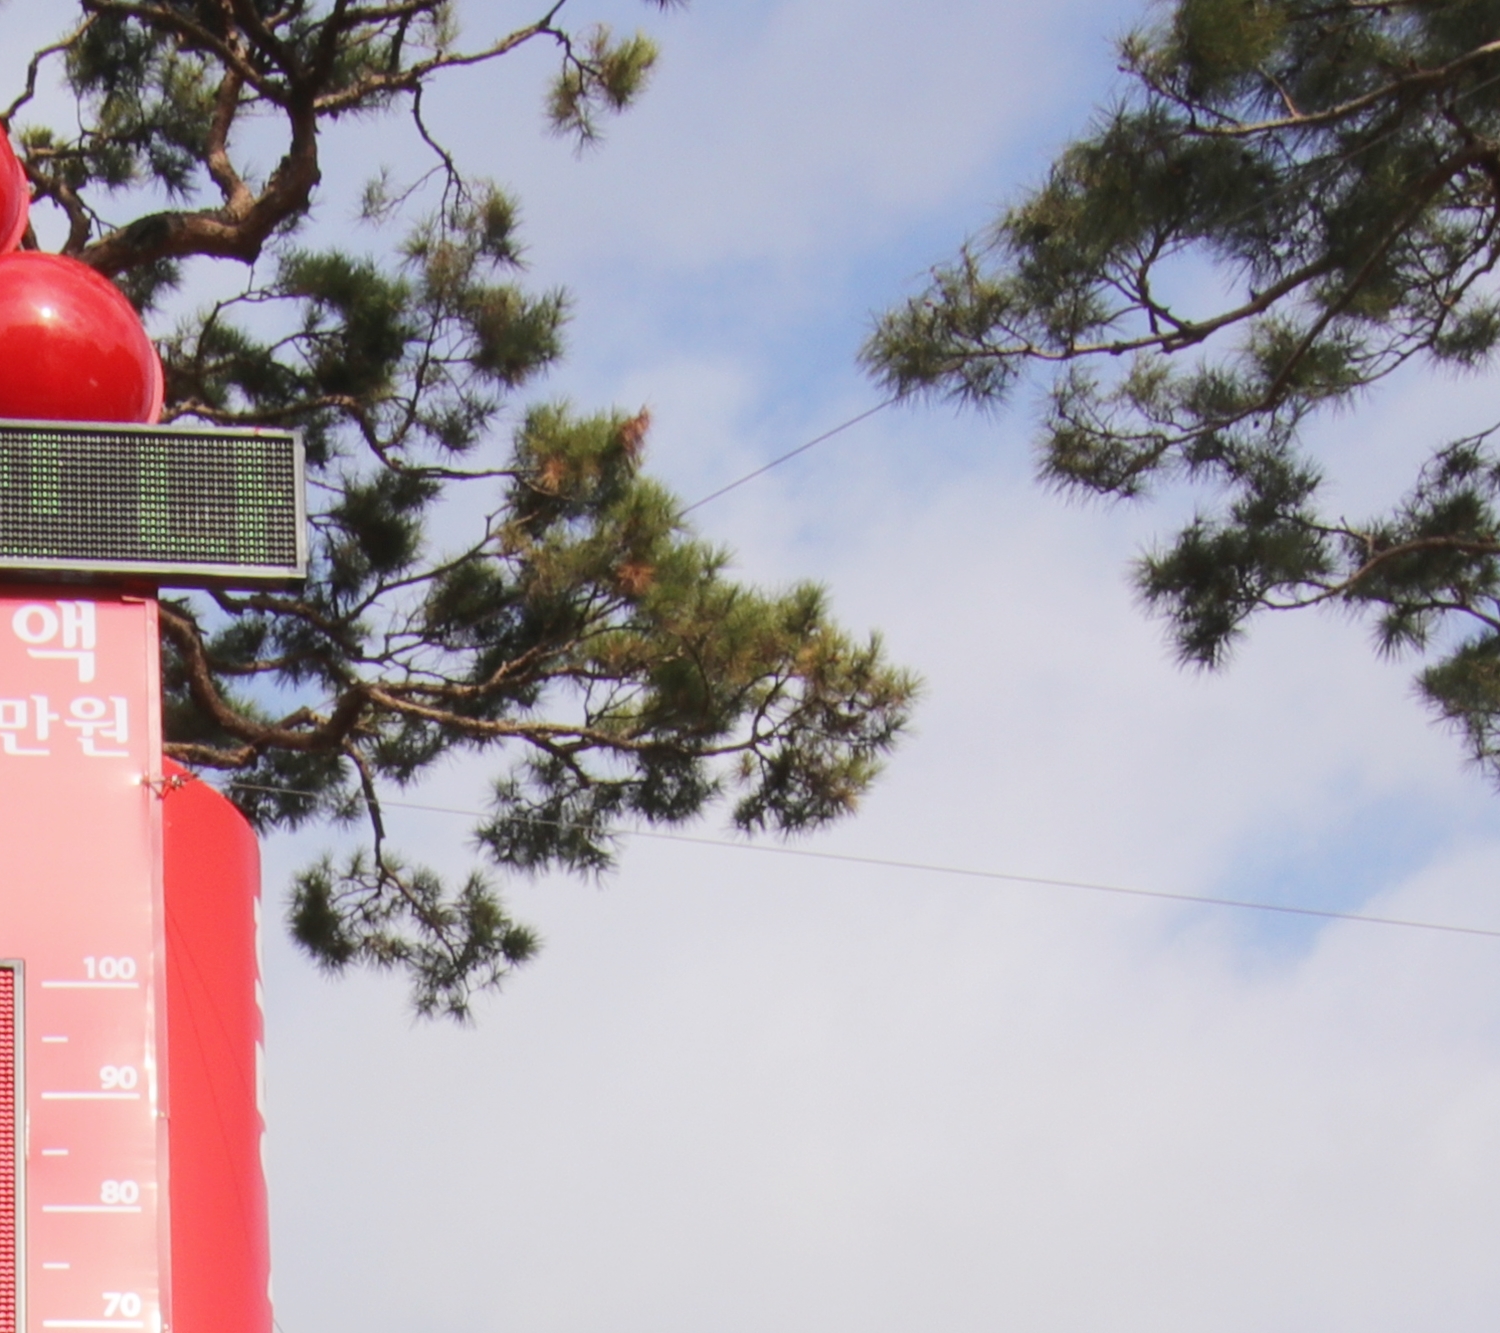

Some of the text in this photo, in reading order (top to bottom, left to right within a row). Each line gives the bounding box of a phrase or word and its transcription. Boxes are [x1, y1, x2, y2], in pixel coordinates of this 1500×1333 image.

[83, 955, 136, 980] 100
[99, 1066, 138, 1090] 90
[100, 1180, 139, 1204] 80
[102, 1293, 141, 1318] 70
